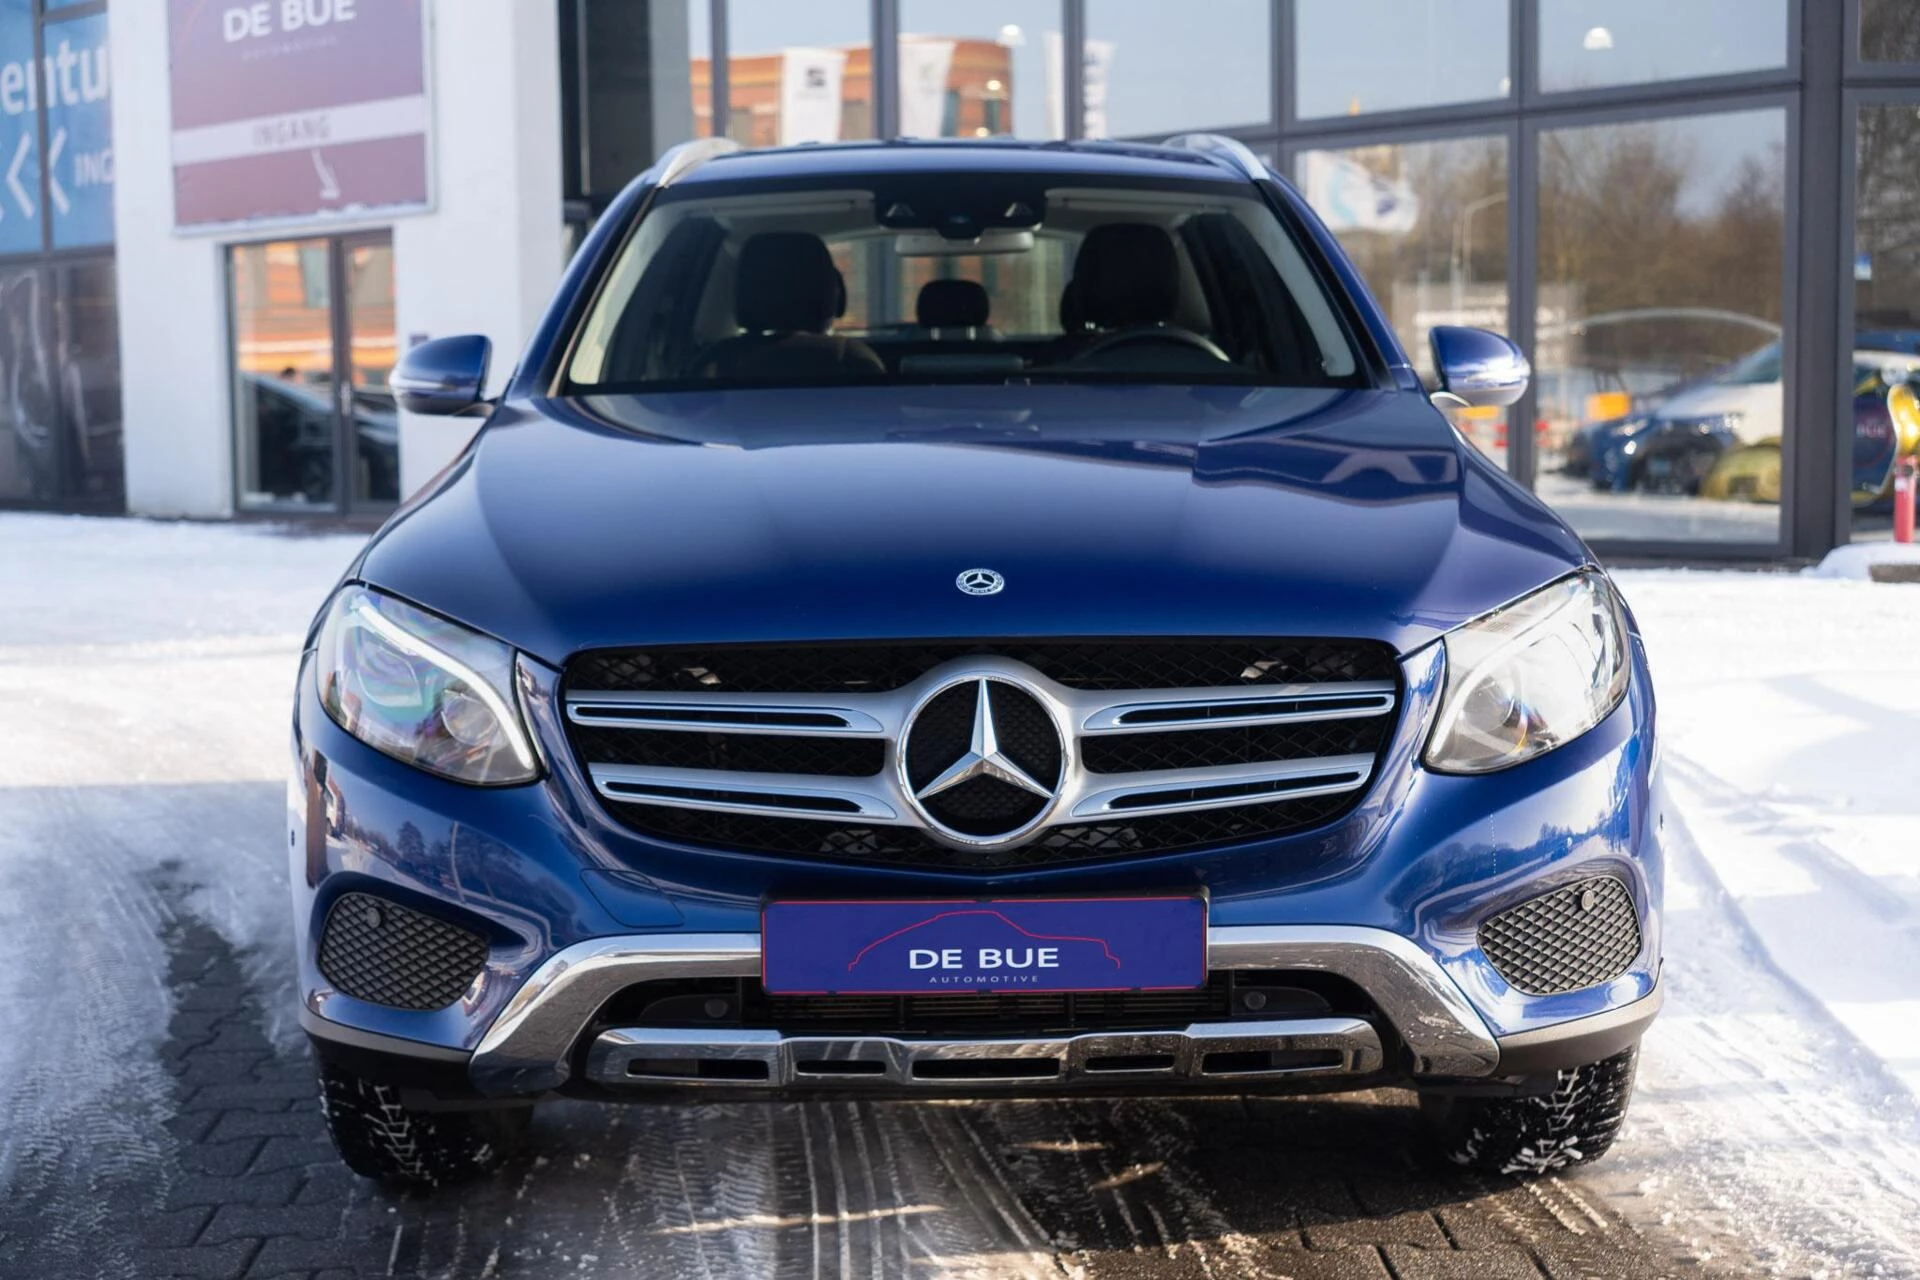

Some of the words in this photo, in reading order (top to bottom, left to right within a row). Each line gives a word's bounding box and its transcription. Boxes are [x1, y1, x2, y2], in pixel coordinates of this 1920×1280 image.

[223, 1, 272, 42] DE
[281, 0, 358, 31] BUE
[909, 949, 963, 970] DE
[979, 947, 1060, 969] BUE
[929, 975, 1039, 984] AUTOMOTIVE
